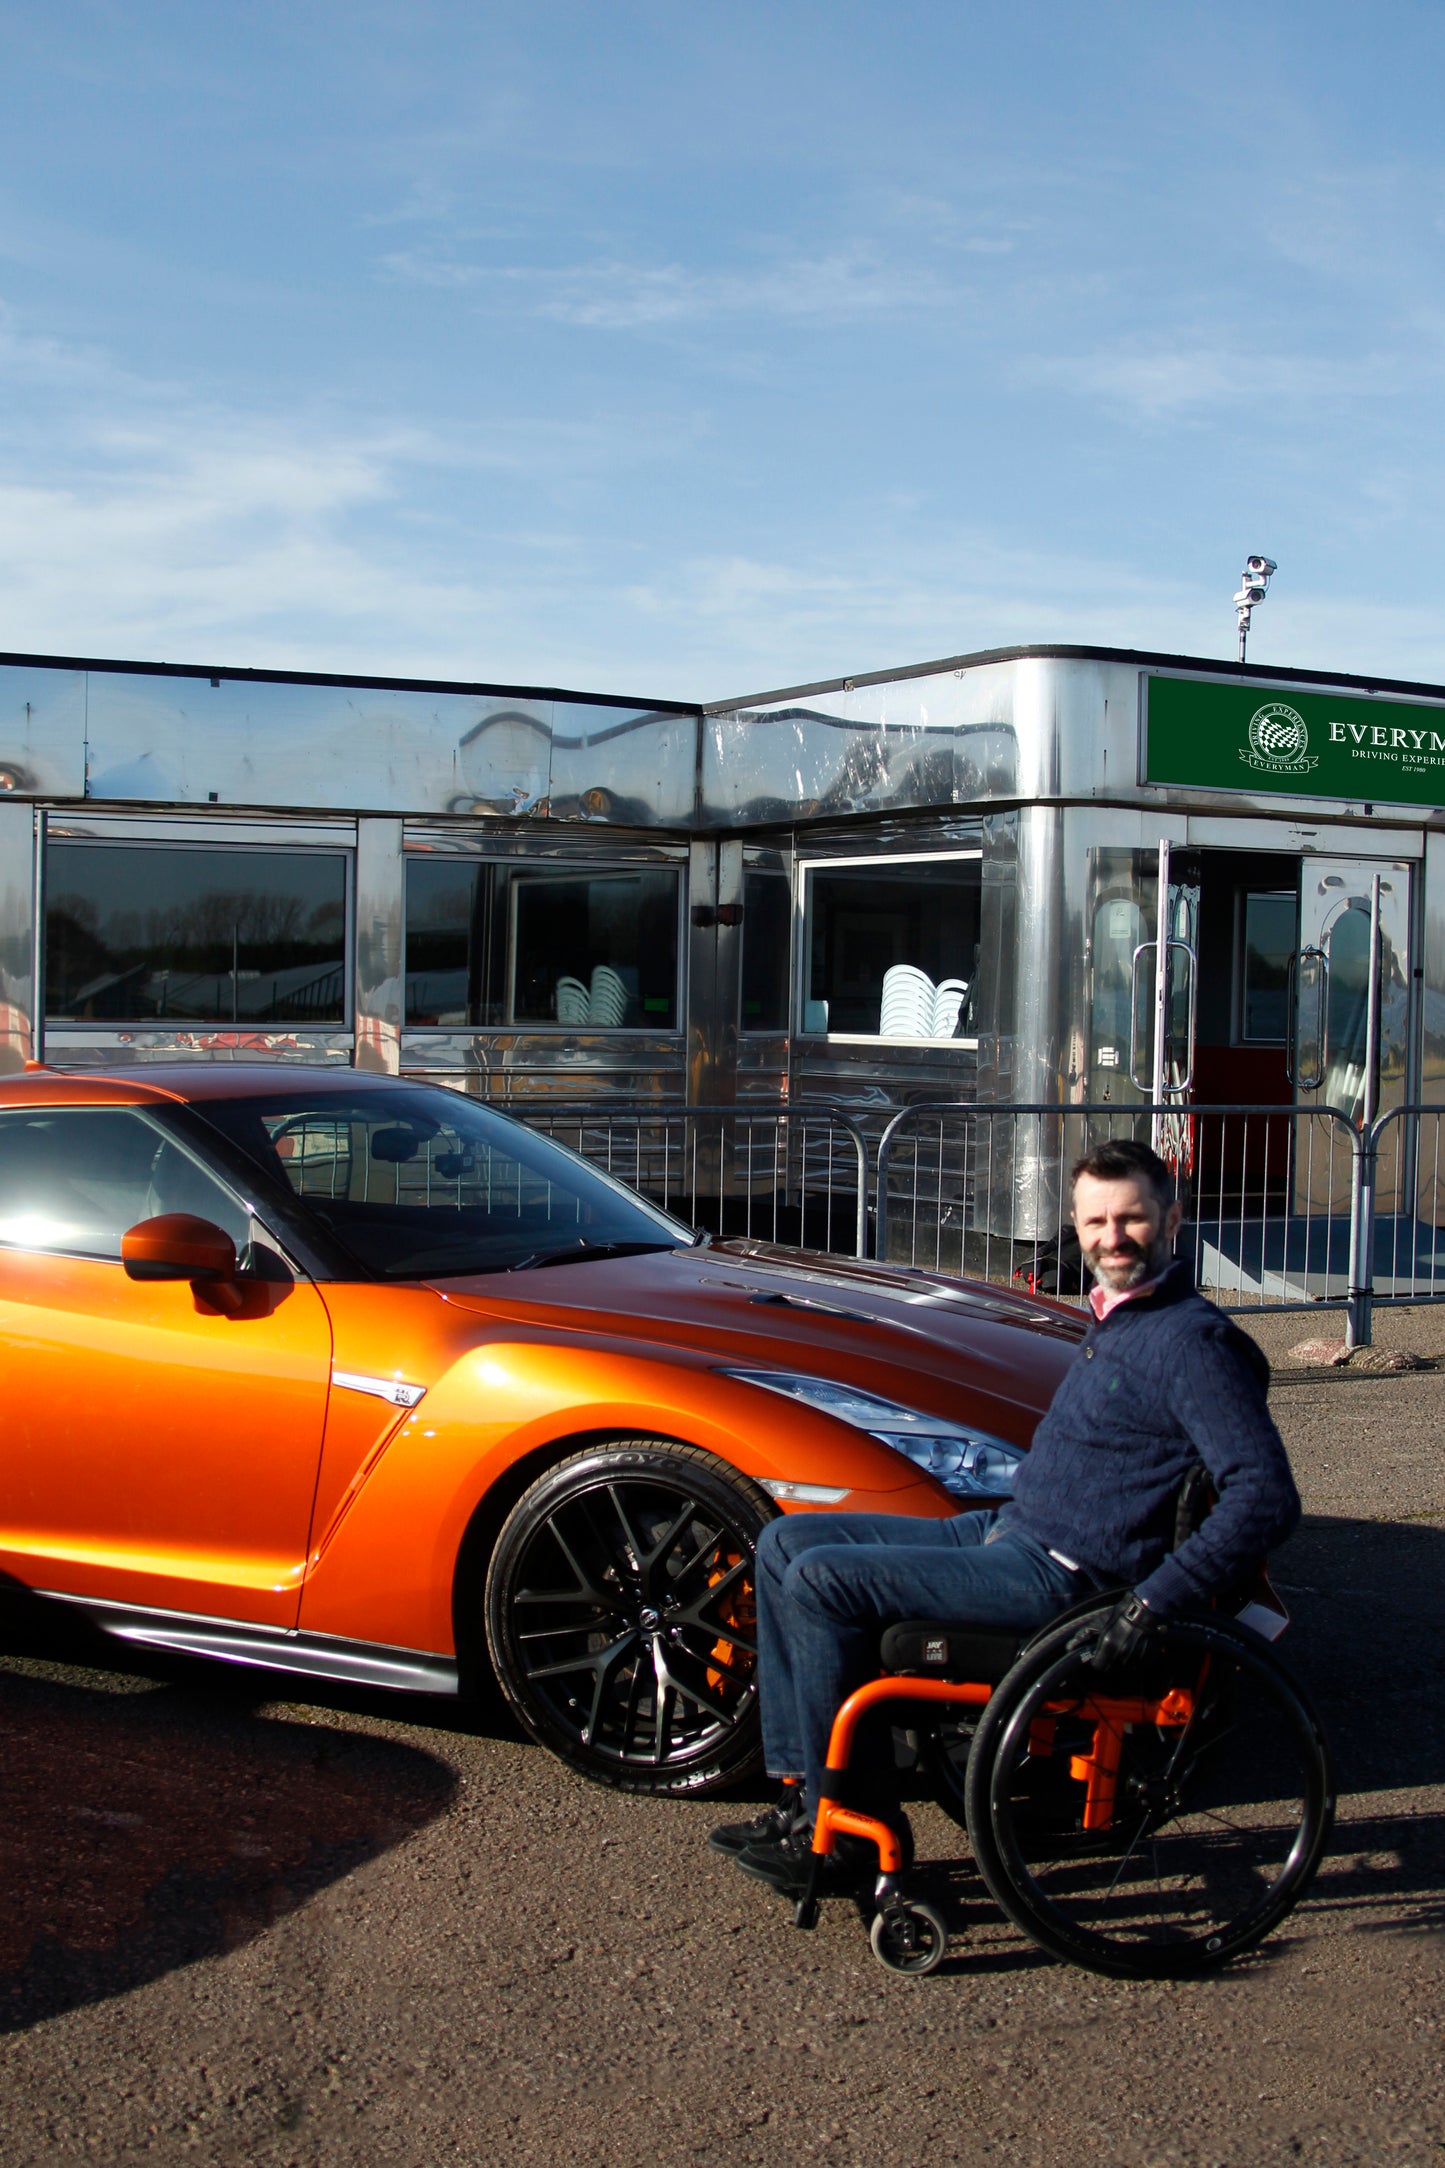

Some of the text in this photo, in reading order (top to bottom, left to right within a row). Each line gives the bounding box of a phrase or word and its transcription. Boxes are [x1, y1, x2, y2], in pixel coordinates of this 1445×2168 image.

[1252, 713, 1264, 746] DRIVING
[1352, 749, 1399, 762] DRIVING
[1253, 759, 1305, 771] EVERYMAN
[926, 1641, 944, 1649] JAY
